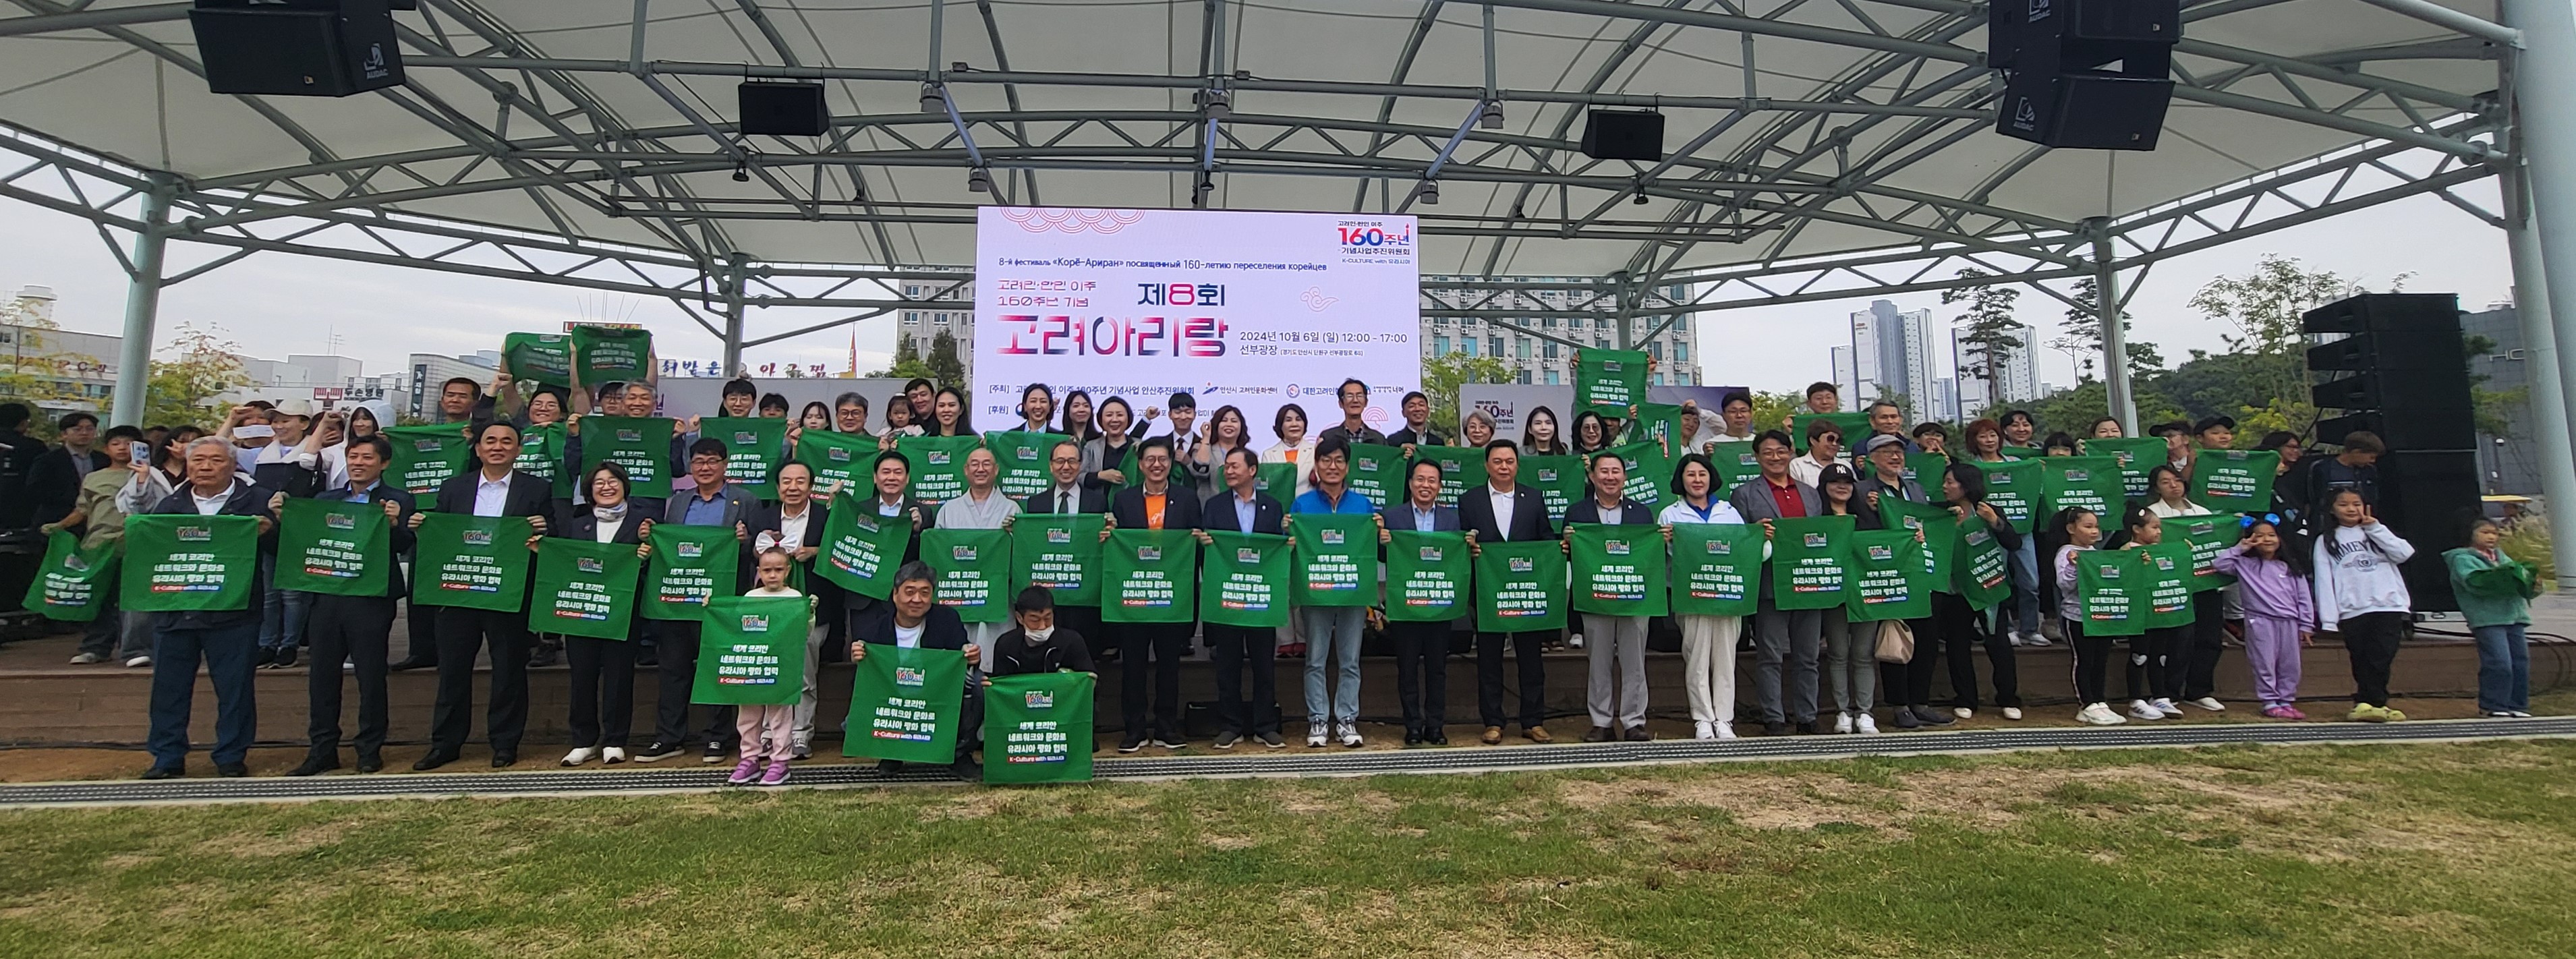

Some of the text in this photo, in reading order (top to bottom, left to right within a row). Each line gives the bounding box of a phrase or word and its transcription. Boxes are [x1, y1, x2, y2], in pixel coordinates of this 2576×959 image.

[2028, 9, 2051, 22] AUDAC
[368, 68, 389, 79] AUDAC
[2013, 121, 2034, 131] AUDAC
[1338, 227, 1410, 246] 160주년
[1341, 247, 1410, 256] 기념사업추진위원회
[1014, 259, 1051, 267] фестиваль
[1126, 260, 1180, 268] посвященный
[1183, 259, 1232, 269] 160-летию
[1234, 261, 1286, 270] переселения
[1288, 262, 1327, 271] корейцев
[1070, 281, 1097, 291] 이주
[1137, 283, 1225, 306] 제8회
[997, 295, 1089, 308] 160주년 기념
[996, 314, 1229, 357] 고려아리랑
[1240, 331, 1276, 342] 2024년
[1279, 331, 1300, 343] 10월
[1303, 331, 1319, 343] 6일
[1322, 332, 1339, 344] (일)
[1342, 333, 1370, 343] 12:00
[1379, 334, 1407, 343] 17:00
[1240, 344, 1278, 355] 선부광장
[989, 385, 1010, 394] [주최]
[1109, 386, 1139, 395] 기념사업
[1220, 386, 1278, 395] 안산시 고려인문화센터
[1475, 403, 1514, 418] 0주년
[732, 644, 769, 654] 세계 코리안
[720, 654, 778, 665] 네트워크와 문화로
[718, 666, 779, 676] 유라시아 평화 협력
[888, 697, 926, 709] 세계 코리안
[876, 707, 936, 720] 네트워크와 문화로
[873, 718, 936, 733] 유라시아 평화 협력
[1019, 721, 1057, 730] 세계 코리안
[1008, 732, 1066, 742] 네트워크와 문화로
[1007, 743, 1068, 753] 유라시아 평화 협력
